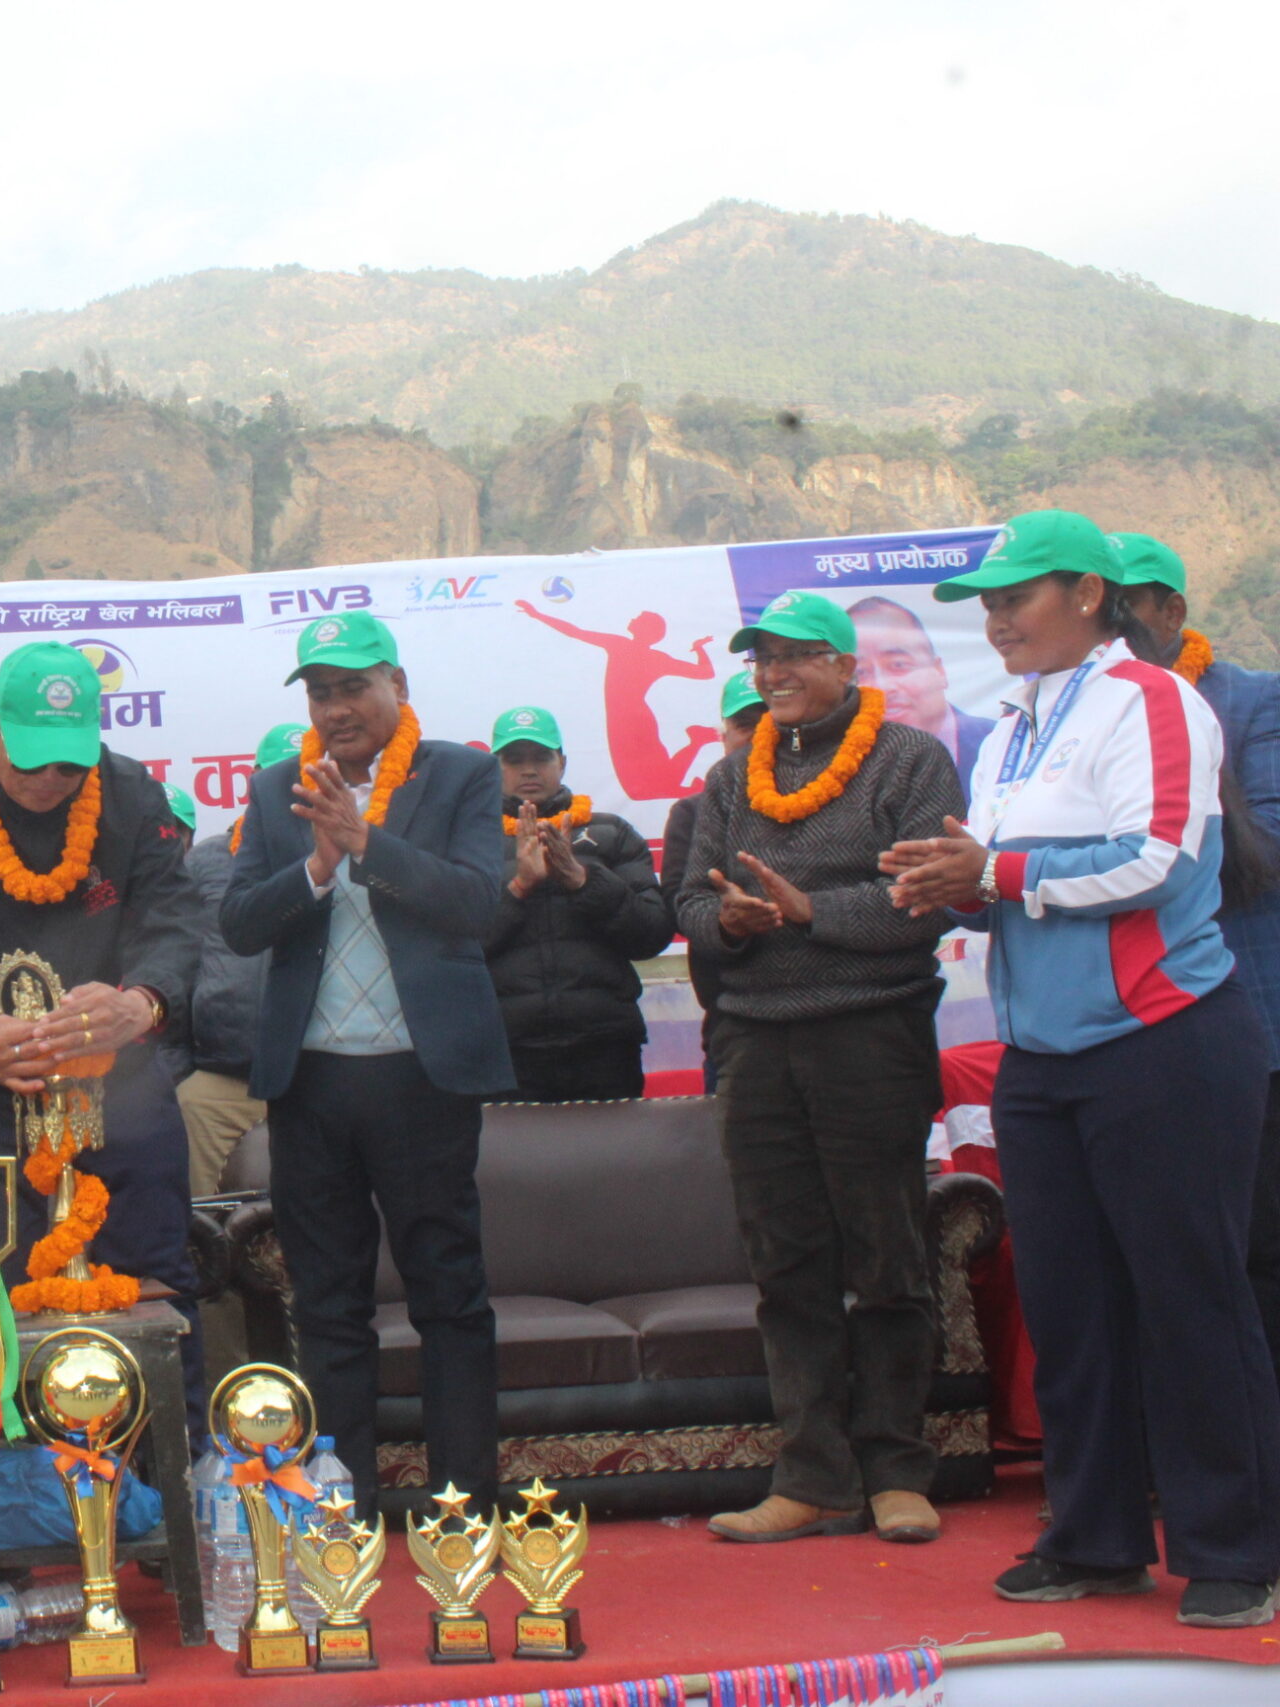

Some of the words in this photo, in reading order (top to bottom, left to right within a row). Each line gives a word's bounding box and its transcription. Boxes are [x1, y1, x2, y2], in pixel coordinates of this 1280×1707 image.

[813, 552, 869, 578] मुख्य
[875, 544, 968, 573] प्रायोजक
[269, 584, 373, 615] FIVB
[426, 574, 499, 601] AVC
[18, 603, 90, 629] राष्ट्रिय
[99, 604, 138, 622] खेल
